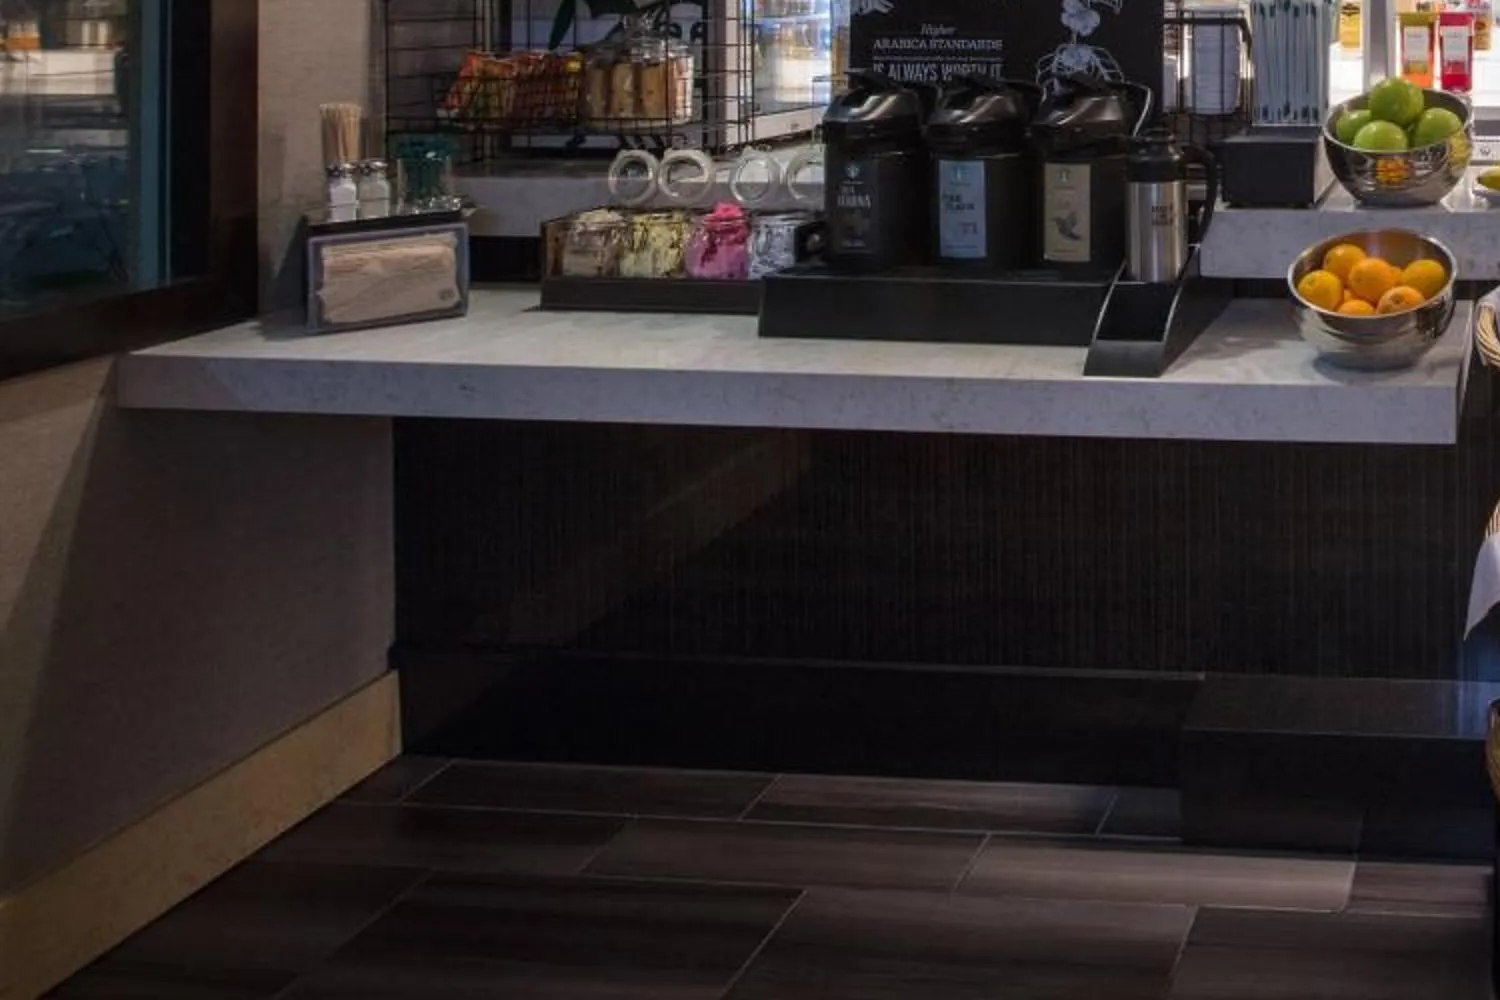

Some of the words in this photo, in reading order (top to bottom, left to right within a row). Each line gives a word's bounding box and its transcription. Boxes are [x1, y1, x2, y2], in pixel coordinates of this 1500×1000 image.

[873, 39, 927, 50] ARABICA
[929, 39, 1003, 51] STANDARDS
[887, 63, 938, 82] ALWAYS
